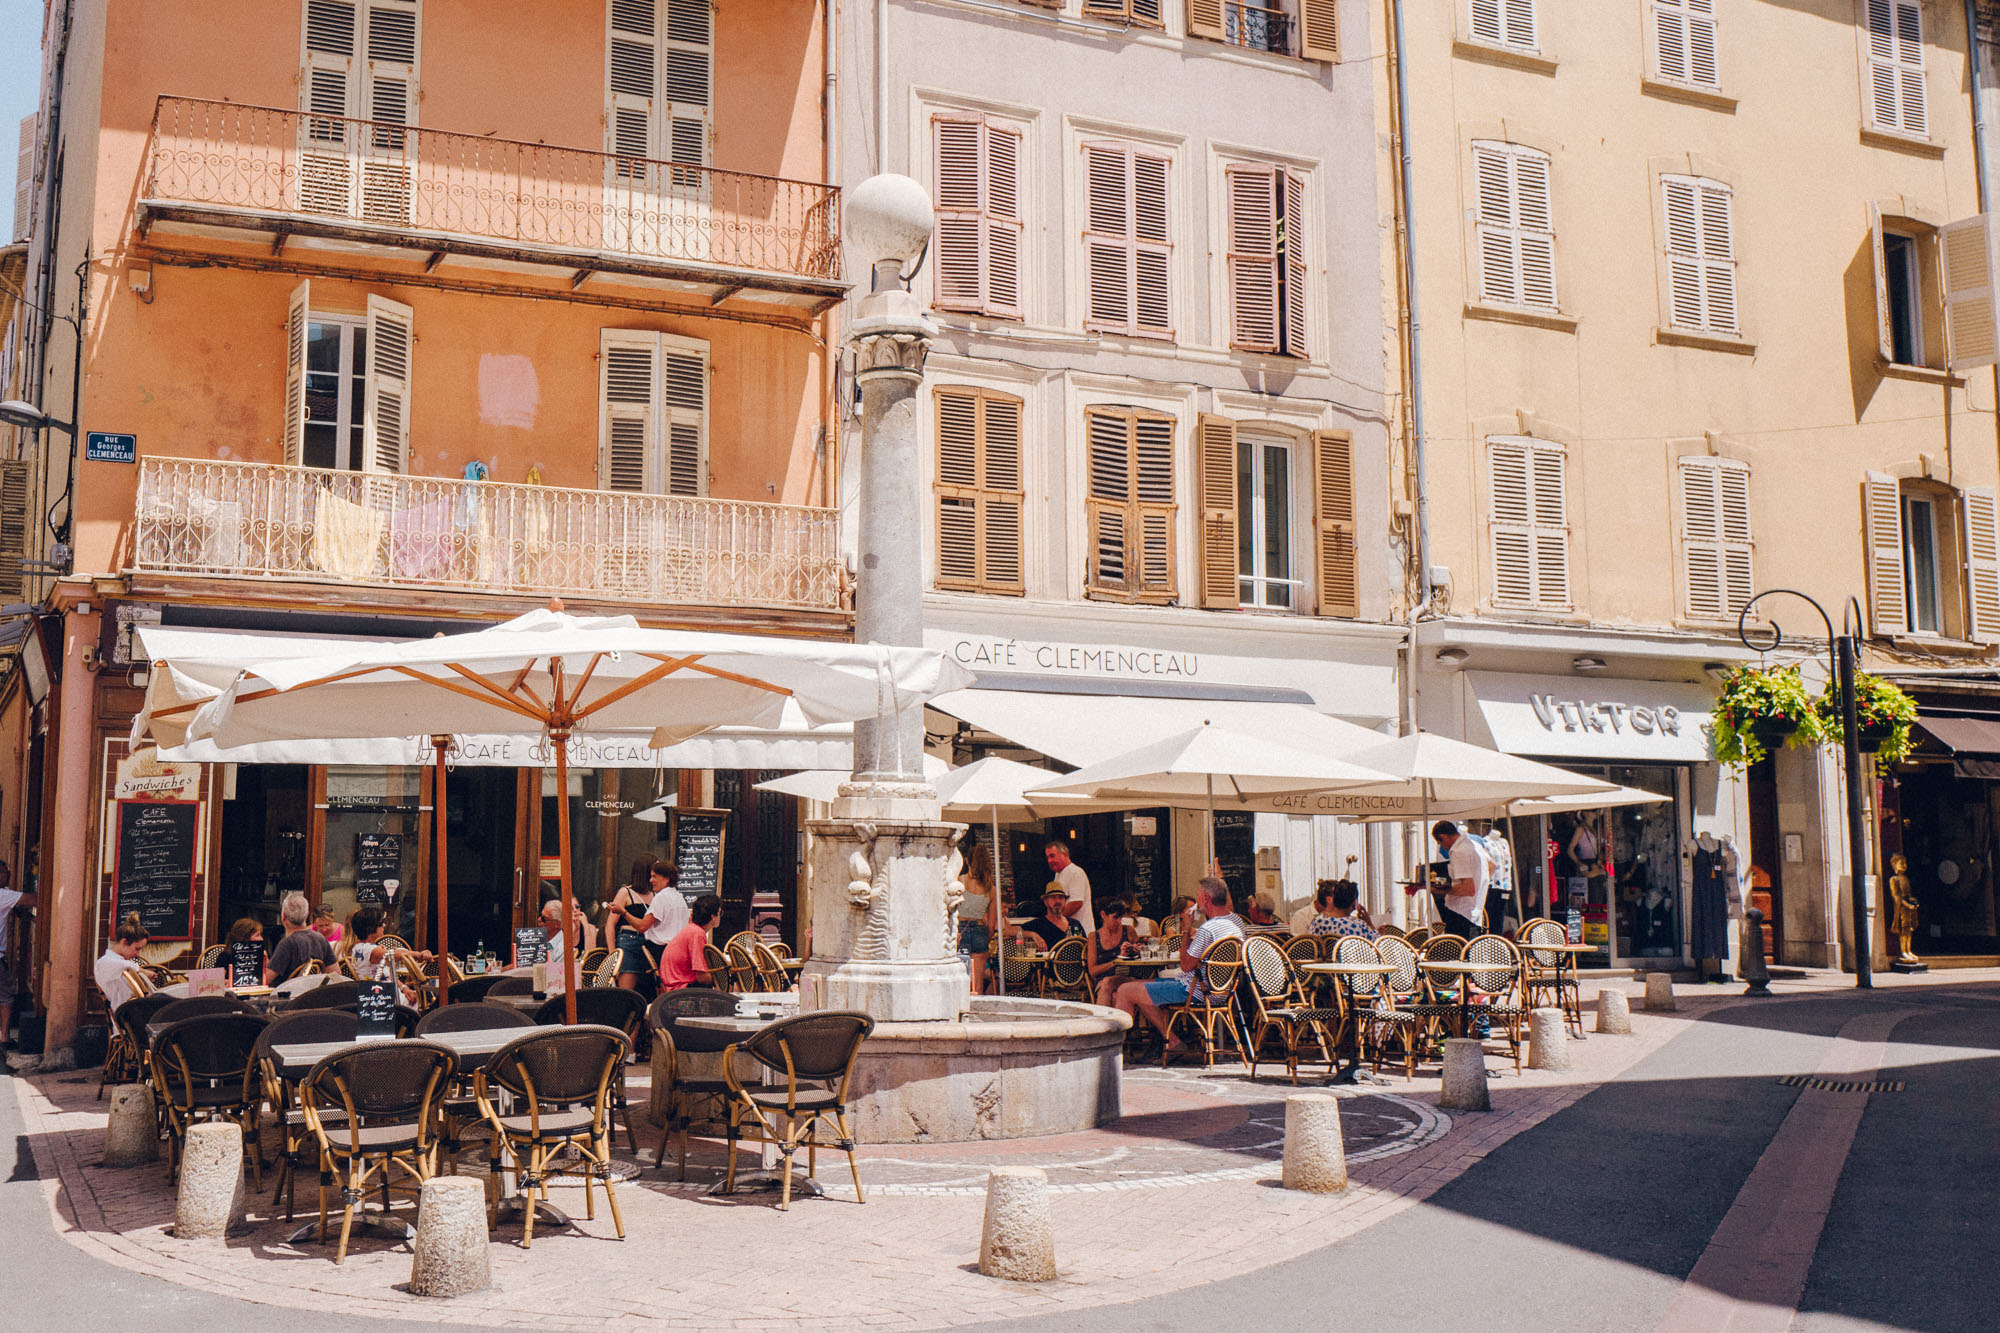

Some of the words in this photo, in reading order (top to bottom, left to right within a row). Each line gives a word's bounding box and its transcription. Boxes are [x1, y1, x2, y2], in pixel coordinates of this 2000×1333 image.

[97, 442, 125, 451] Georges
[89, 450, 133, 459] CLEMENCEAU
[954, 639, 1017, 666] CAFÉ
[1036, 646, 1198, 676] CLEMENCEAU
[1529, 692, 1681, 736] VIKTOR
[463, 741, 511, 760] CAFÉ
[528, 745, 652, 761] CMENCEAU
[122, 776, 192, 793] Sandwiches
[326, 796, 380, 804] CLEMENCEAU
[585, 801, 635, 809] CLEMENCEAU
[1272, 794, 1308, 808] CAFÉ
[1317, 796, 1405, 809] CLEMENCEAU
